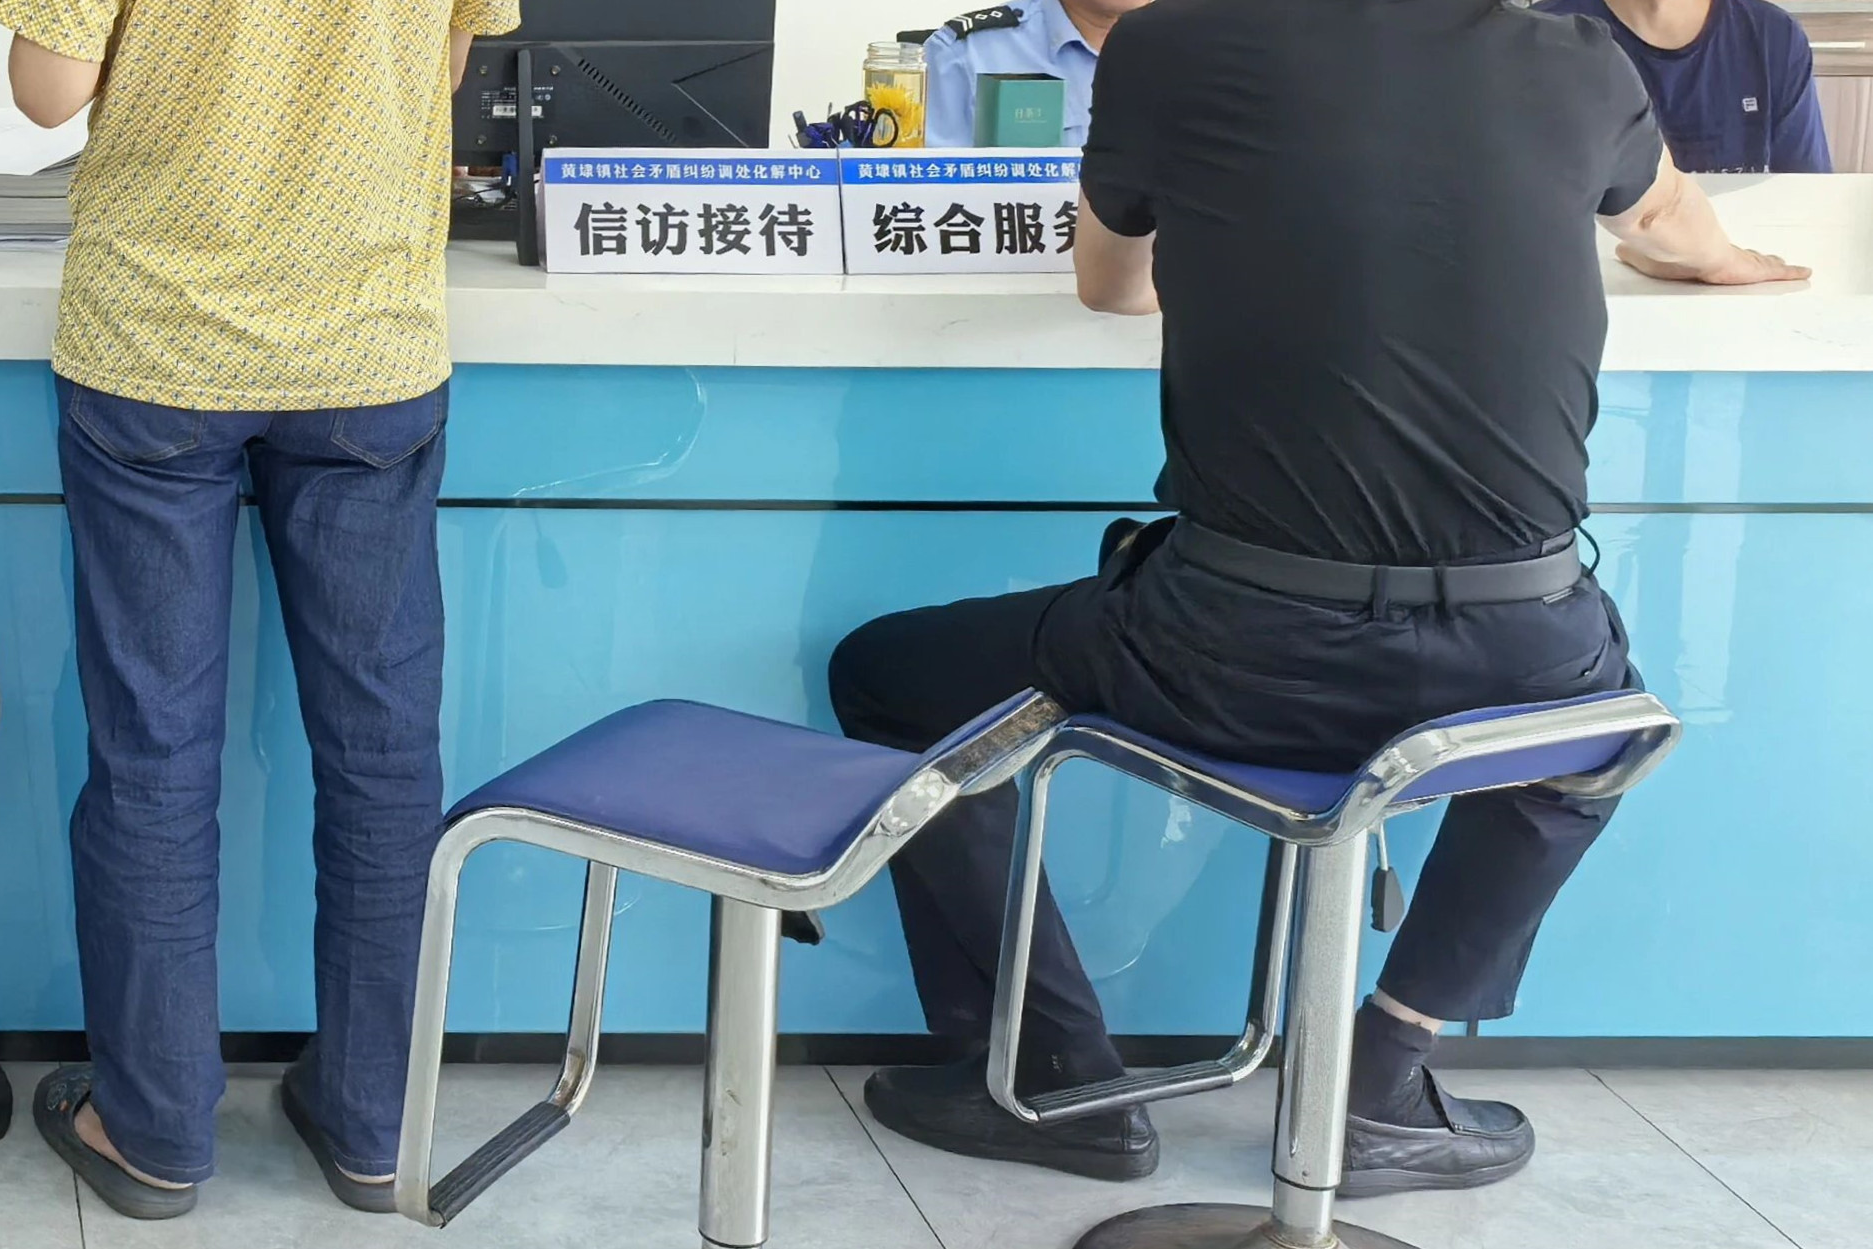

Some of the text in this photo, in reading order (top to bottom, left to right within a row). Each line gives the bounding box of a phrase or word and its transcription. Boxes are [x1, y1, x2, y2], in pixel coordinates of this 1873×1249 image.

[561, 162, 821, 180] 黄埭镇社会矛盾纠纷调处化解中心
[858, 162, 1081, 179] 黄埭镇社会矛盾纠纷调处化解
[574, 202, 813, 257] 信访接待
